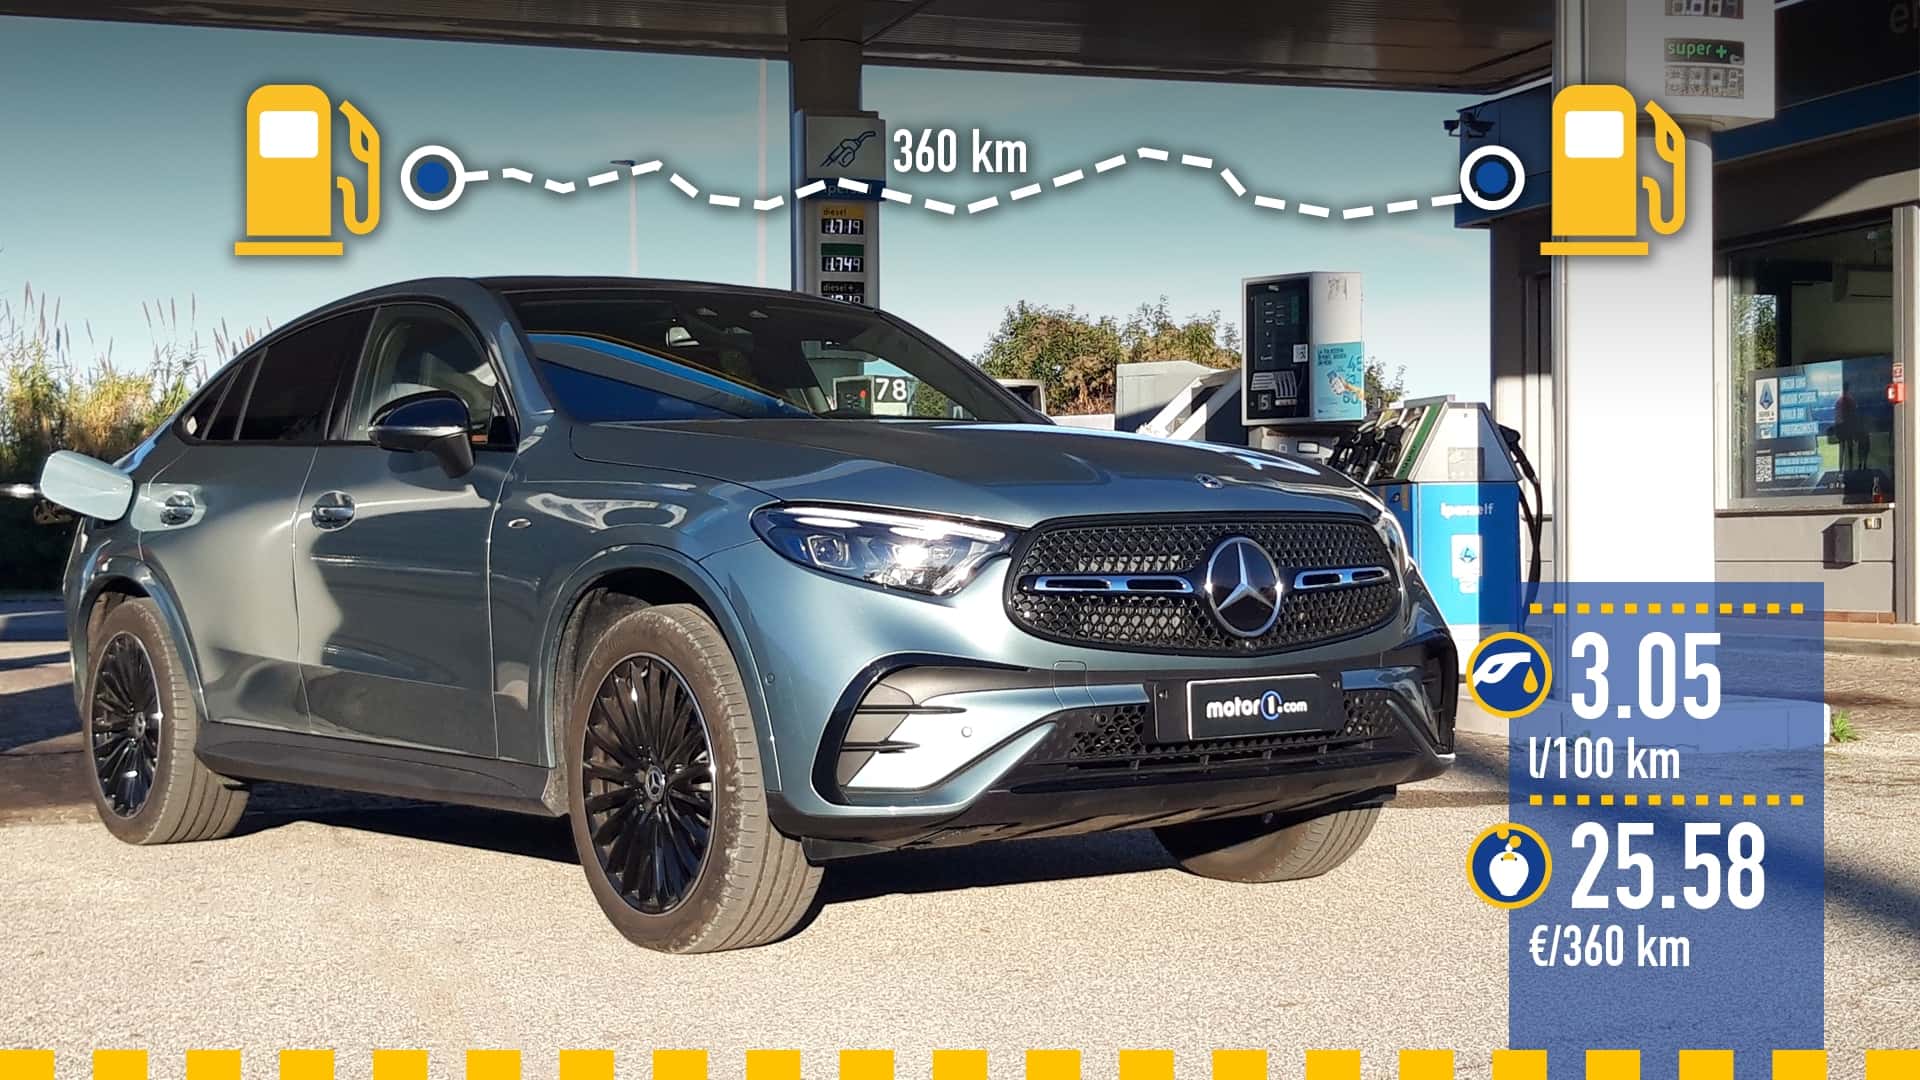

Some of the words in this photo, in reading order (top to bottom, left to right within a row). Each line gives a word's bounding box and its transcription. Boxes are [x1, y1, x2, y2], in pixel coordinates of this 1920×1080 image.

[1668, 43, 1712, 59] super
[823, 207, 847, 216] diesel
[875, 379, 907, 400] 78
[1206, 691, 1308, 720] motor1.com
